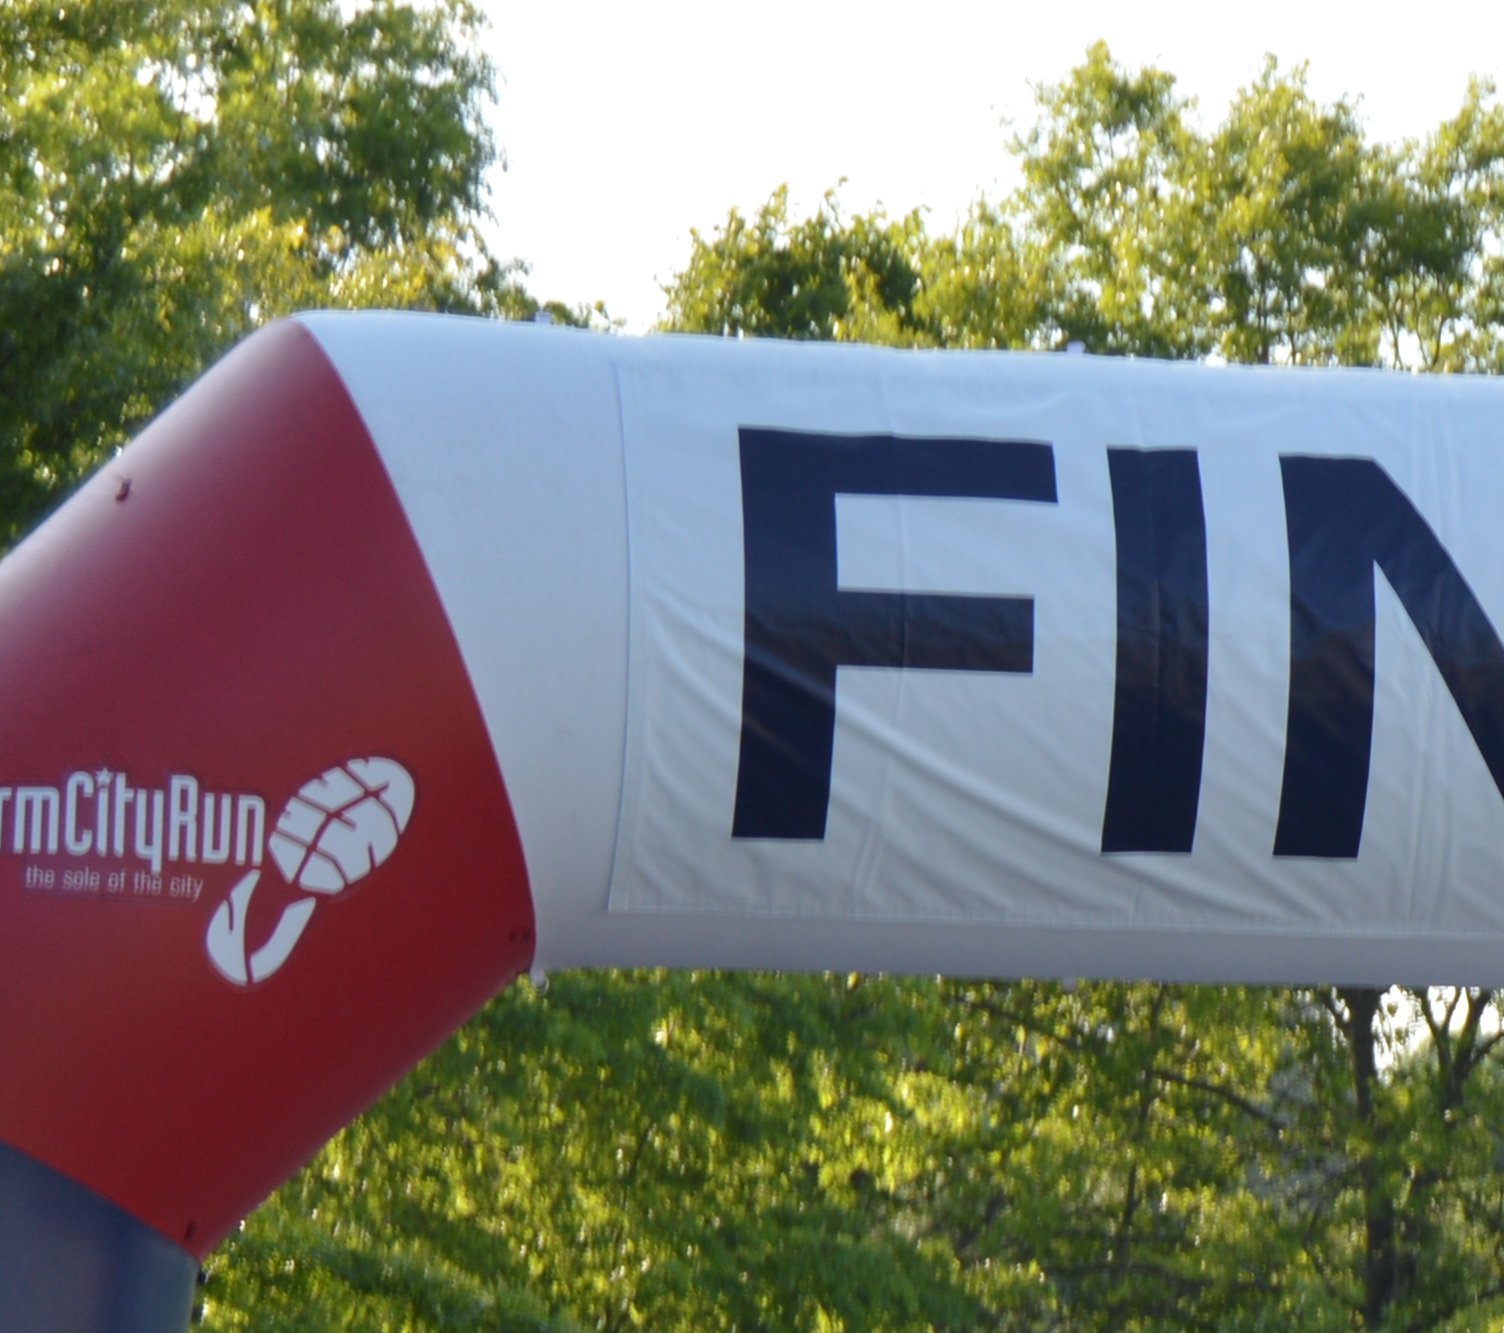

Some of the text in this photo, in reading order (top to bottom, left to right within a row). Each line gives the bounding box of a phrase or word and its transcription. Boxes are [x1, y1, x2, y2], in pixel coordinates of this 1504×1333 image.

[26, 865, 204, 901] the sole of the city
